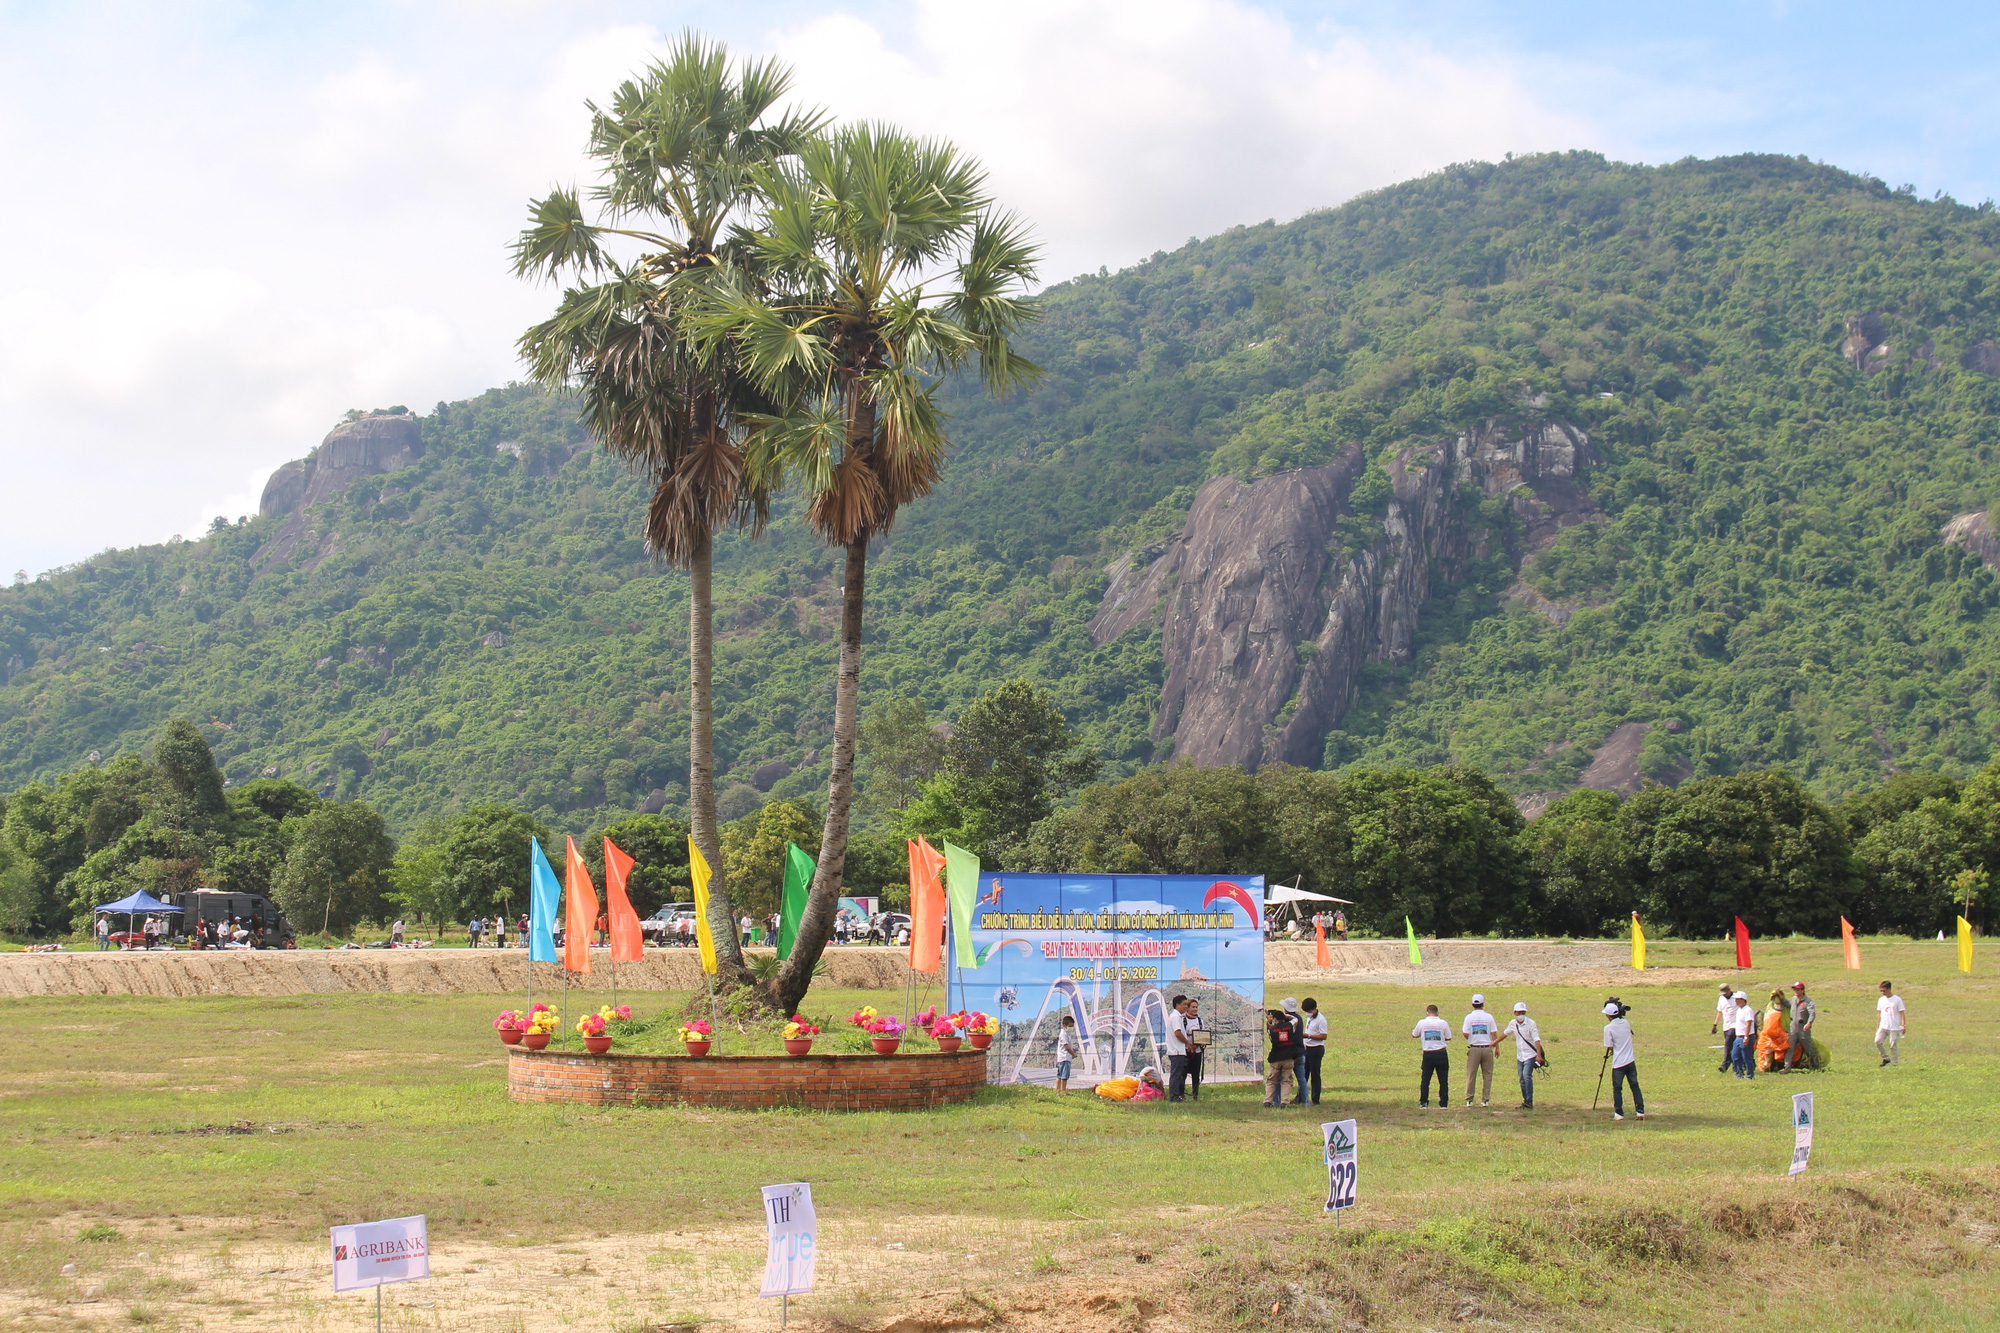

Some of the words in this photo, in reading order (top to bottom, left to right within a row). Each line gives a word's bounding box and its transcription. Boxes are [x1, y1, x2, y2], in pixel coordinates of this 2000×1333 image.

[981, 910, 1008, 930] CHƯƠNG
[1009, 908, 1030, 930] TRÌNH
[1030, 905, 1047, 930] BIỂU
[1065, 909, 1074, 930] DÙ
[1113, 910, 1130, 933] LƯỢN
[1132, 910, 1141, 930] CÓ
[1142, 910, 1159, 933] ĐỘNG
[1170, 910, 1178, 929] VÀ
[1180, 910, 1194, 929] MÁY
[1194, 913, 1207, 929] BAY
[1208, 910, 1218, 929] MÔ
[1218, 909, 1234, 929] HÌNH
[1061, 938, 1080, 958] TRÊN
[1080, 941, 1104, 960] PHỤNG
[1105, 938, 1128, 957] HOÀNG
[1129, 940, 1142, 957] SƠN
[1143, 938, 1158, 957] NĂM
[1070, 967, 1095, 980] 30/4
[1104, 966, 1158, 980] 01/5/2022
[1326, 1161, 1356, 1210] 622
[767, 1196, 792, 1224] TH
[350, 1236, 425, 1260] AGRIBANK
[771, 1229, 813, 1264] true
